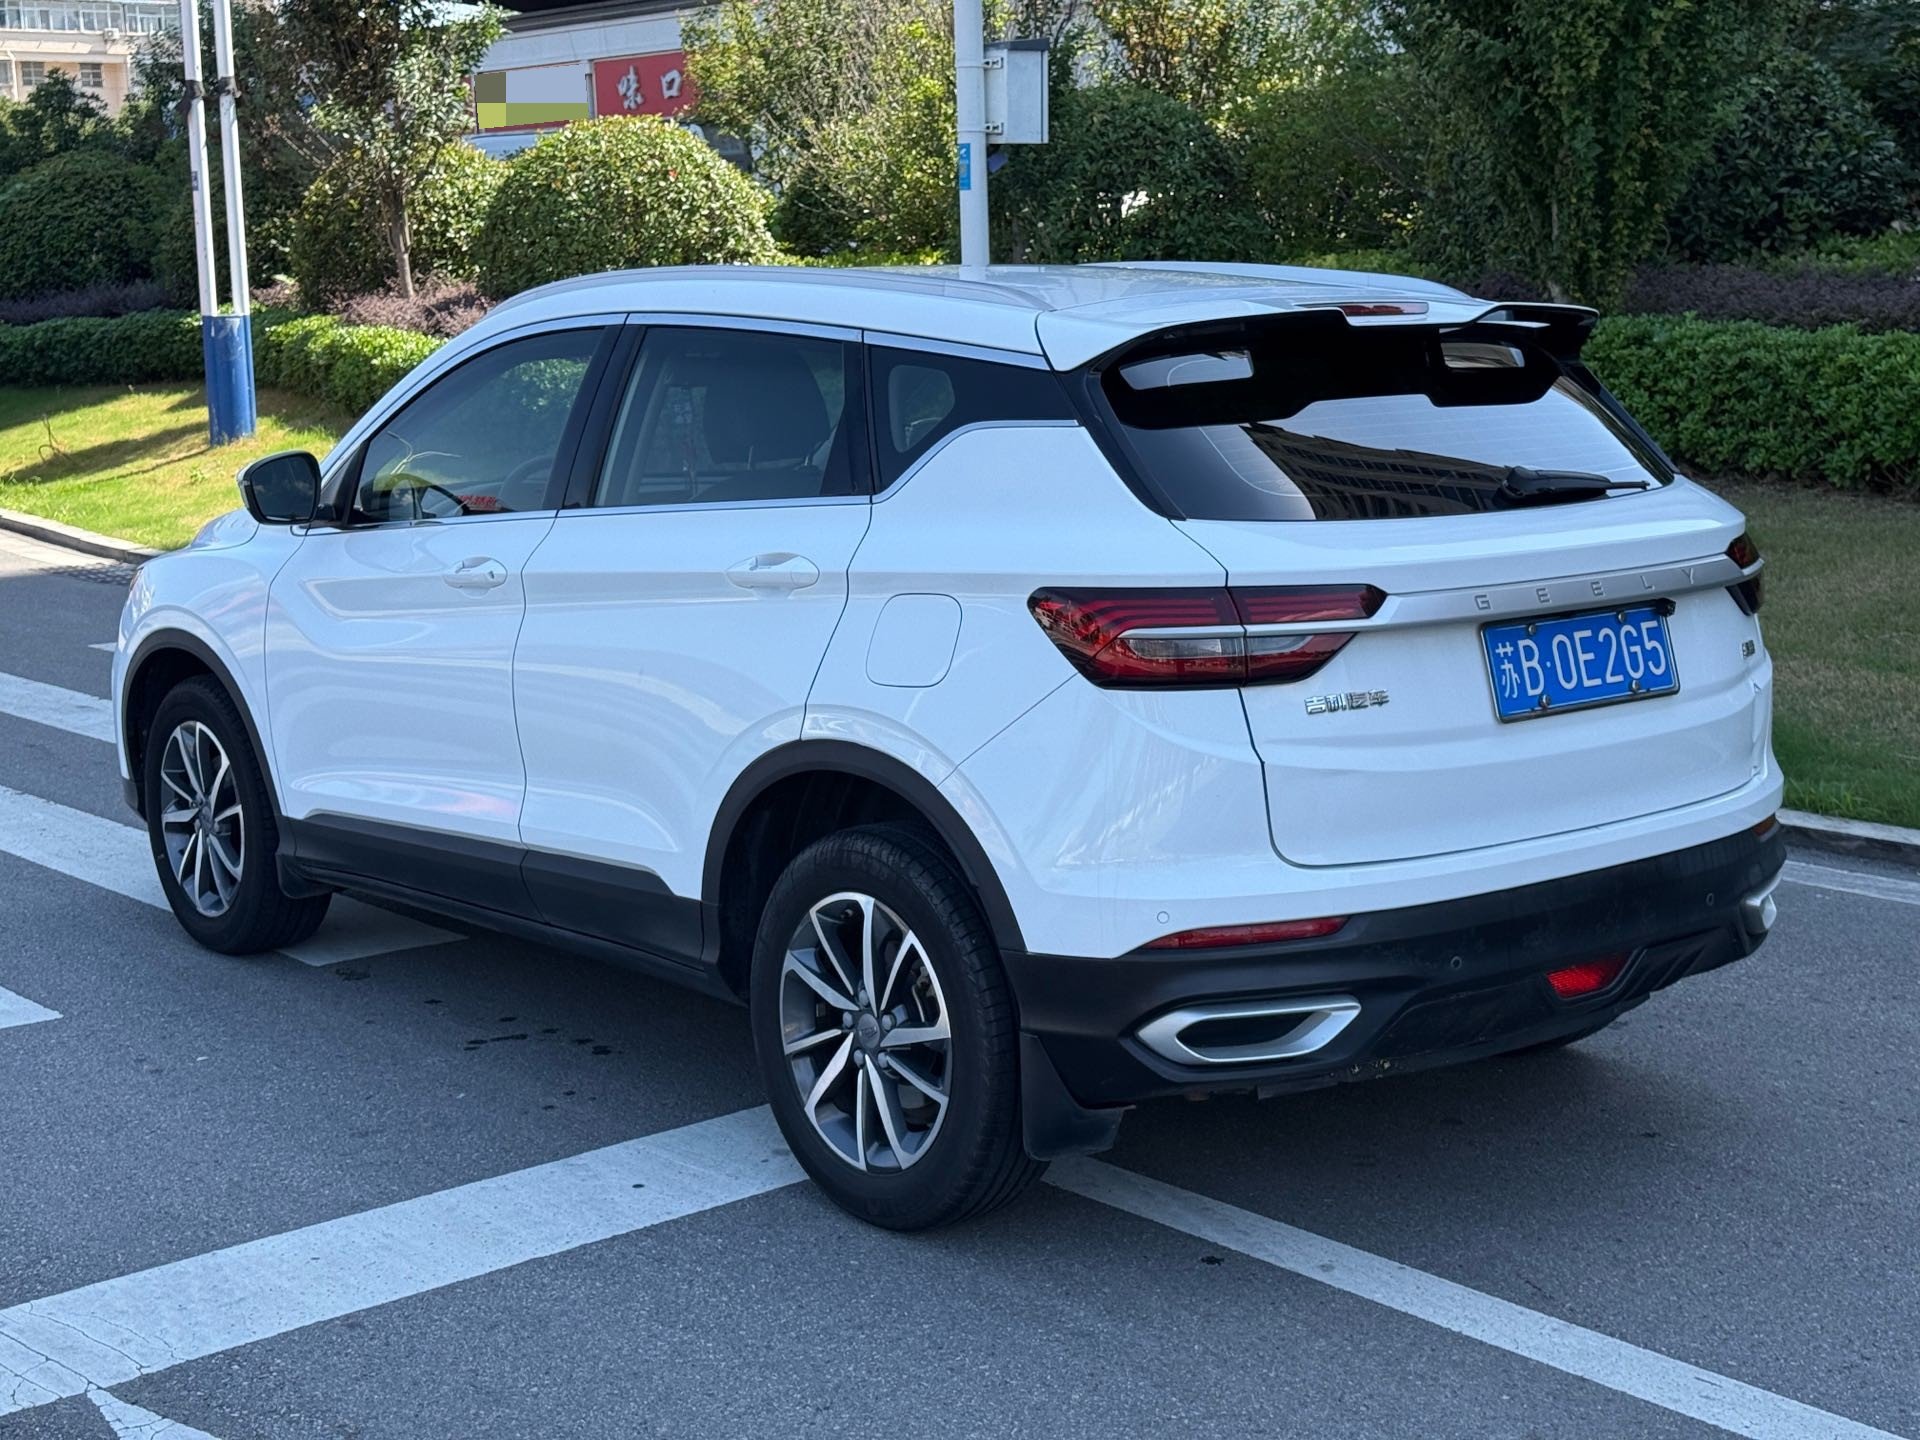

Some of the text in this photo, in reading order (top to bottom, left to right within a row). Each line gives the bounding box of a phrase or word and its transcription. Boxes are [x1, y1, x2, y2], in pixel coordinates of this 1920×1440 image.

[1474, 567, 1695, 611] GEELY
[1304, 689, 1390, 715] 吉利汽车
